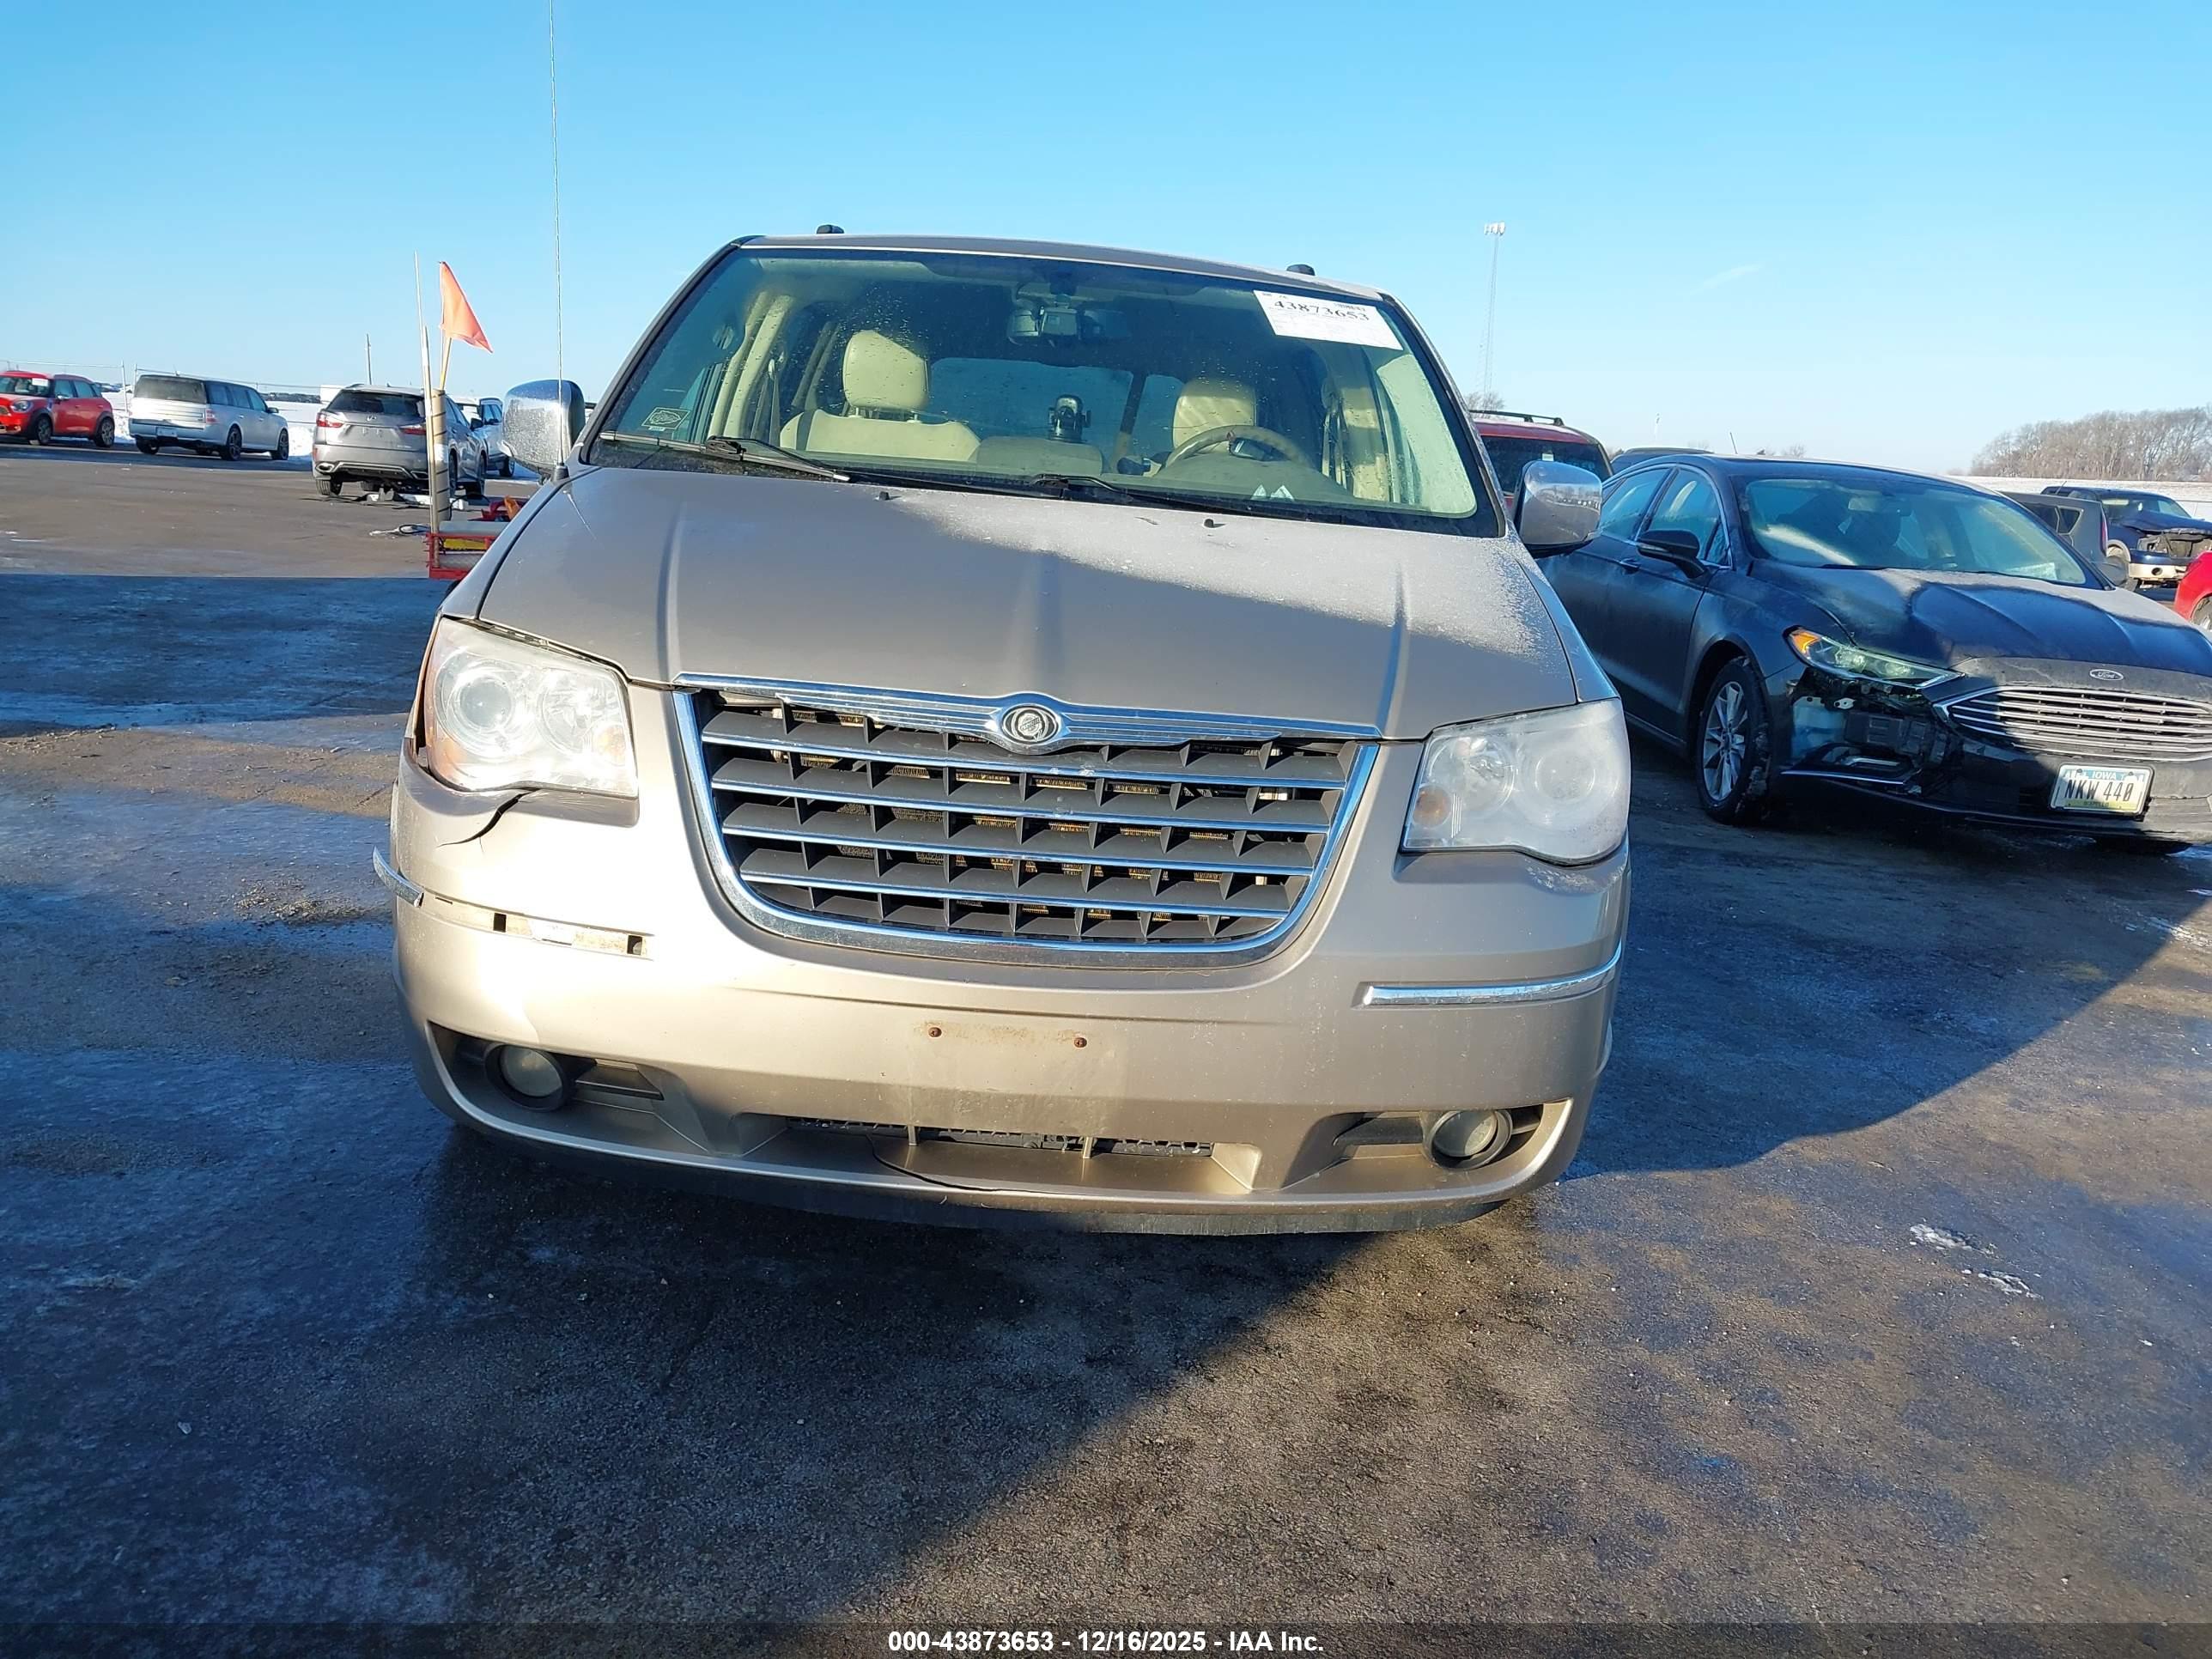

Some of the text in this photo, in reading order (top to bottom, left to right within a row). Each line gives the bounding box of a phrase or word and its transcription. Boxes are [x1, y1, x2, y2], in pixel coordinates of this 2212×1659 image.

[1273, 300, 1370, 321] 43873653
[2091, 770, 2117, 781] IOWA
[2064, 779, 2135, 802] NKW 440
